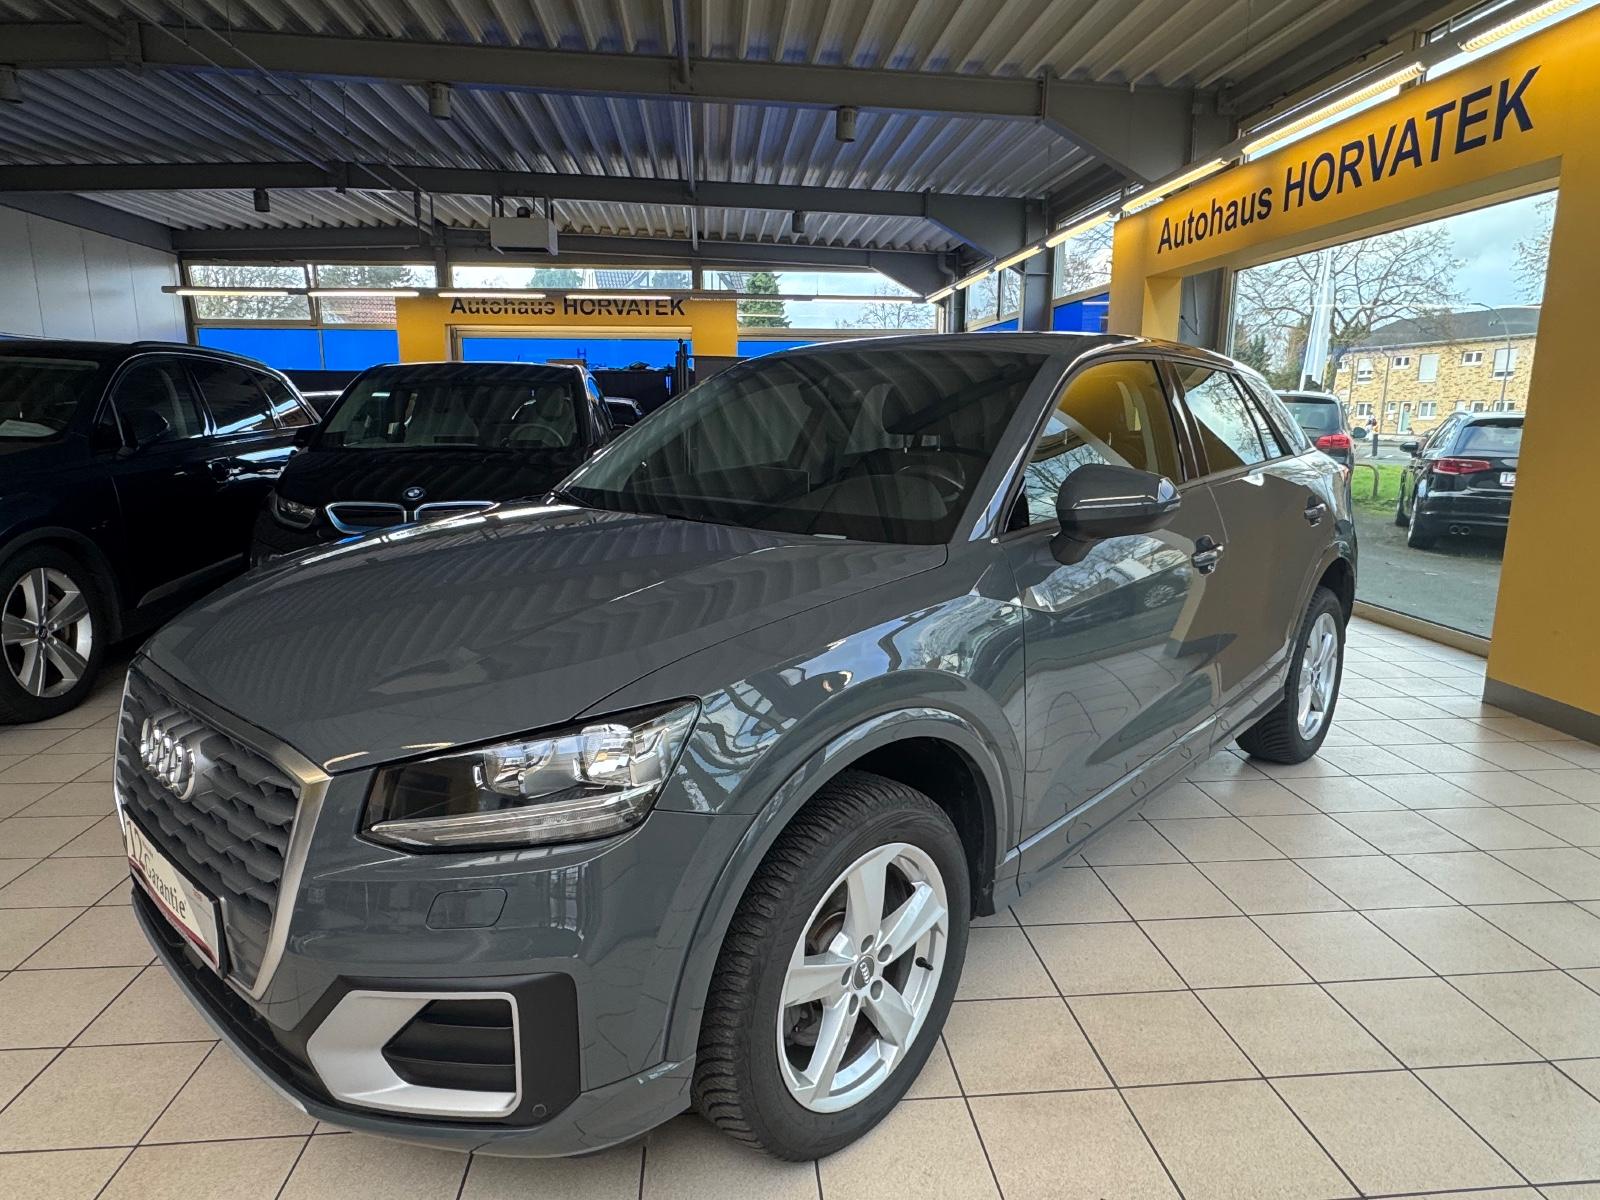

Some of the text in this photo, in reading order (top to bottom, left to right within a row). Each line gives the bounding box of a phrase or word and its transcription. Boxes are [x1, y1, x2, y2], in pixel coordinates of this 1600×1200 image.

[1157, 65, 1542, 254] Autohaus HORVATEK
[451, 297, 685, 315] Autohaus HORVATEK
[144, 853, 187, 919] Garantie
